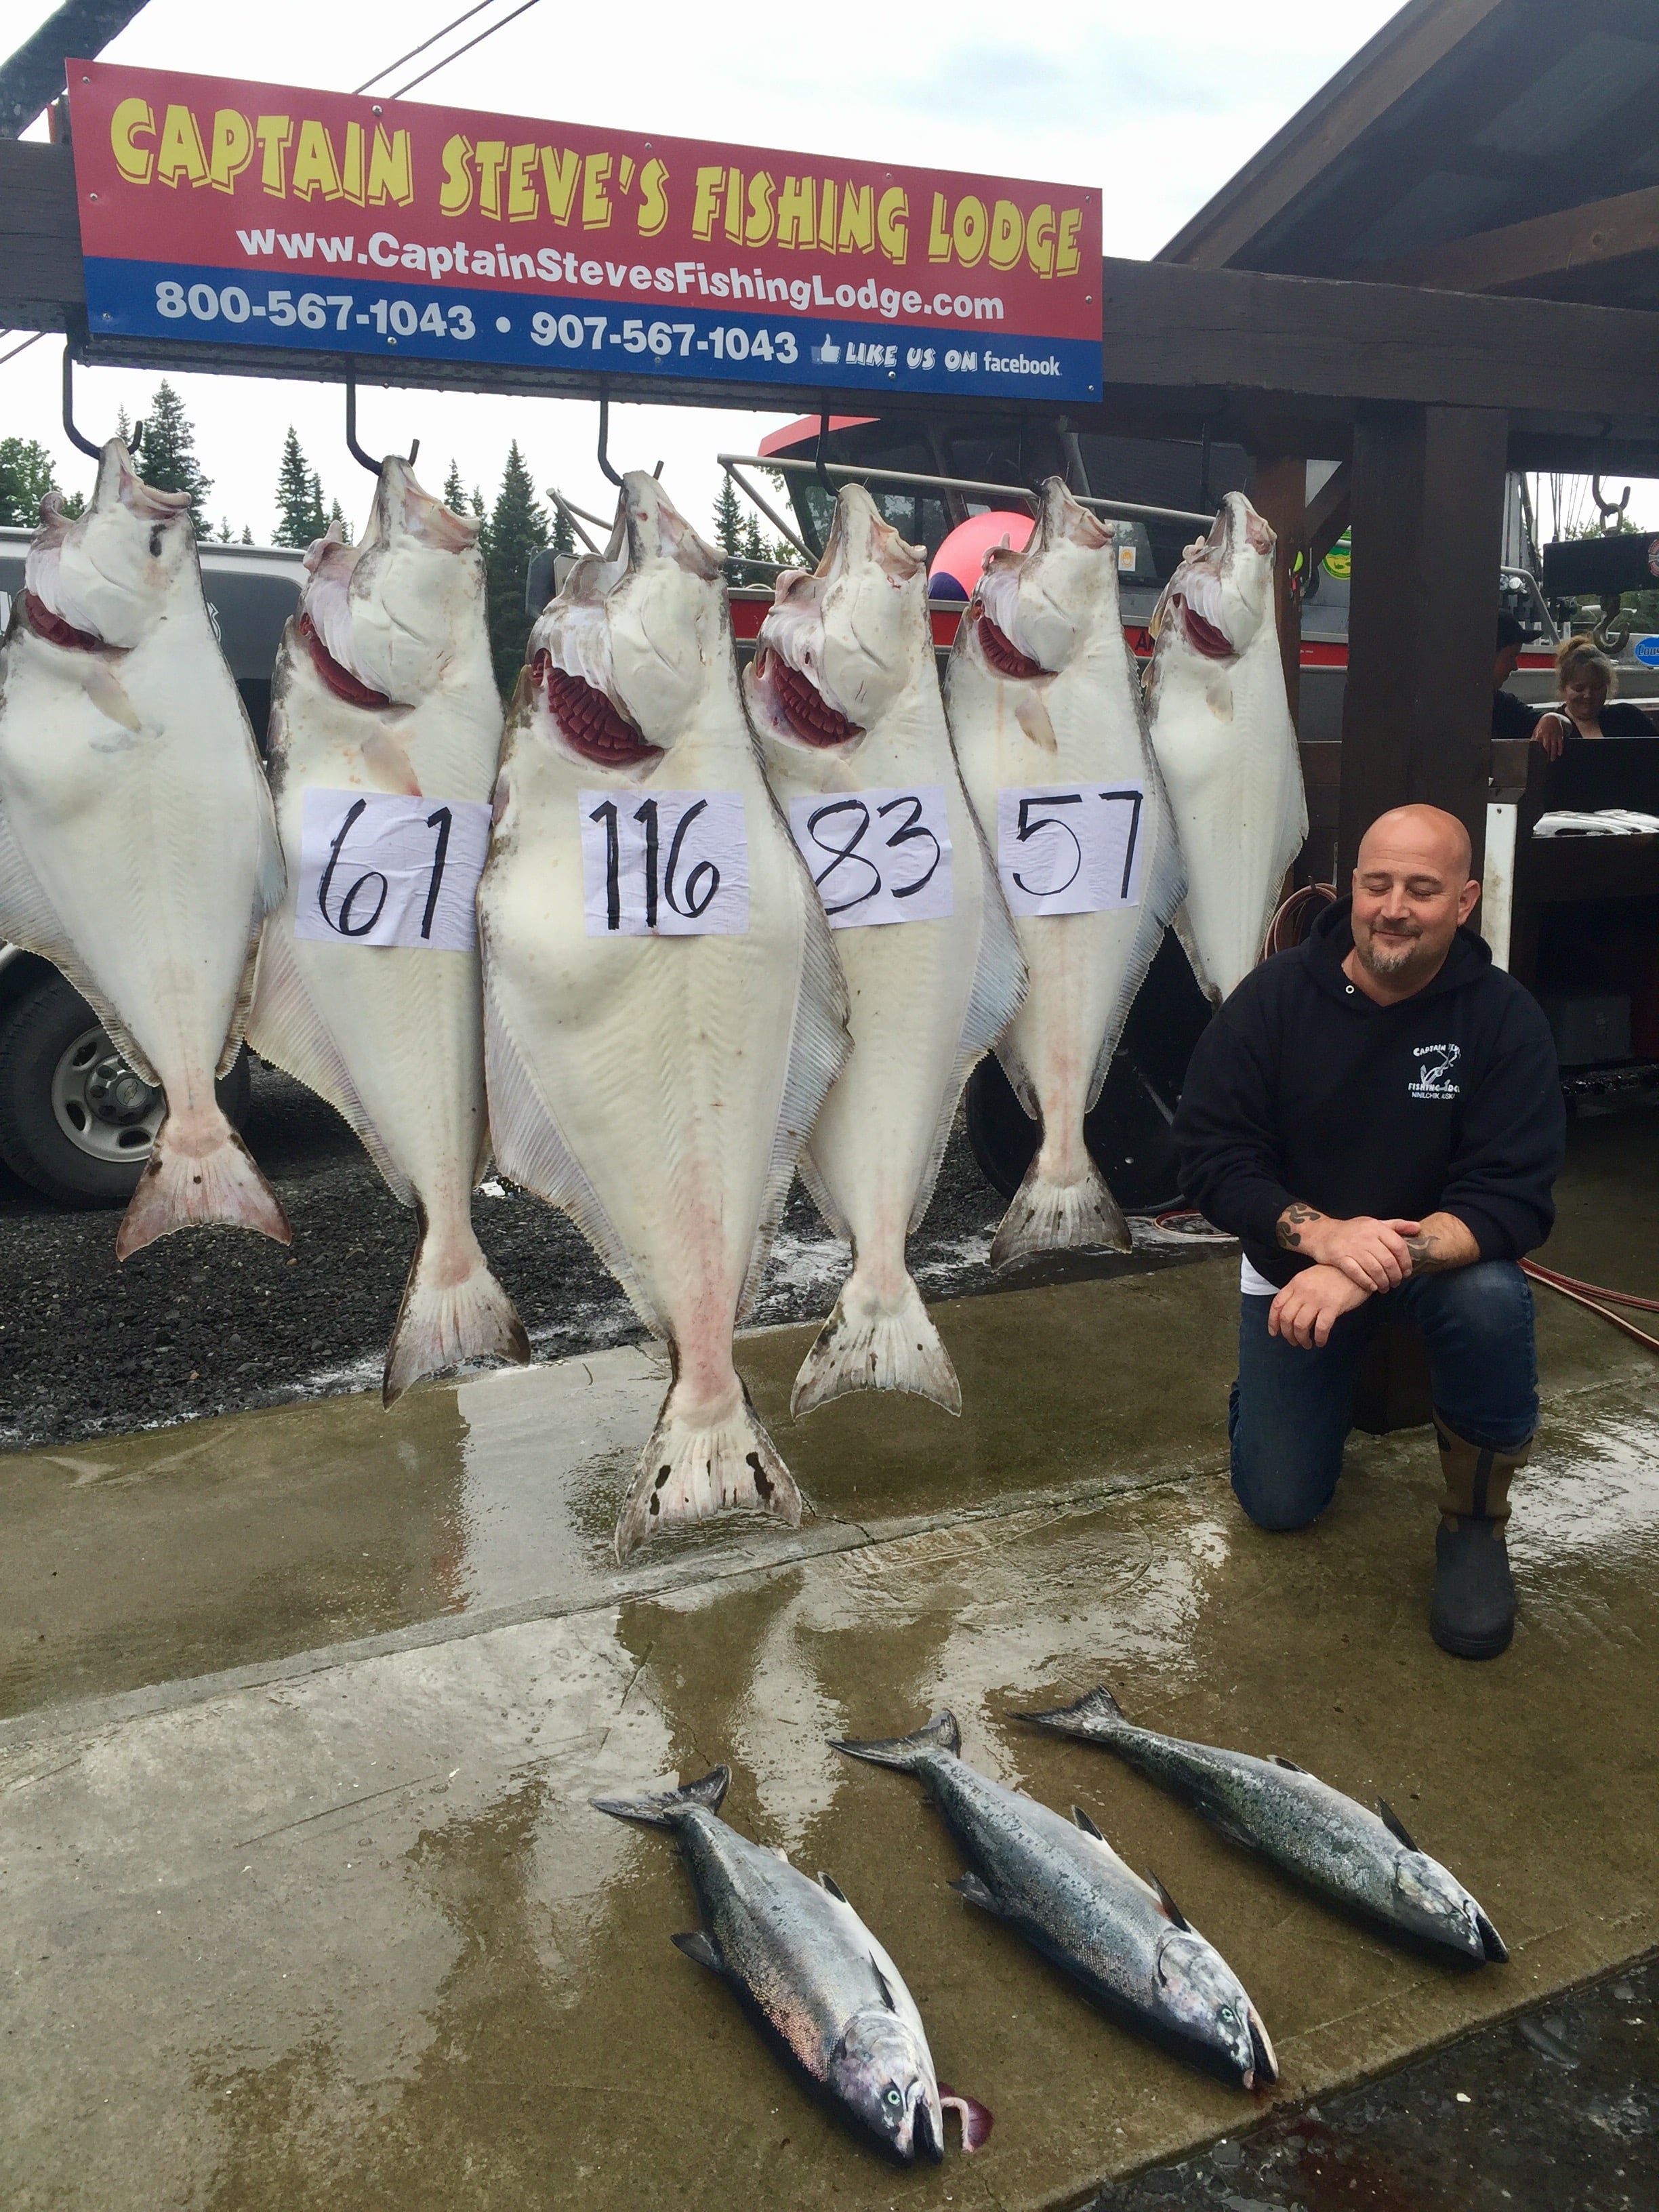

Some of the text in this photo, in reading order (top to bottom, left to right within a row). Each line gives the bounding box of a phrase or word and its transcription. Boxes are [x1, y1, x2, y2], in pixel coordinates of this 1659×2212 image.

[110, 98, 1084, 279] CAPTAIN STEVE'S FISHING LODGE
[155, 281, 1061, 376] 800-567-1043 907-567-1043 LIKE US ON facebook
[317, 798, 453, 940] 61
[588, 798, 720, 930] 116
[807, 796, 941, 916] 83
[1012, 790, 1144, 899] 57
[1413, 1044, 1446, 1057] CAPTAIN
